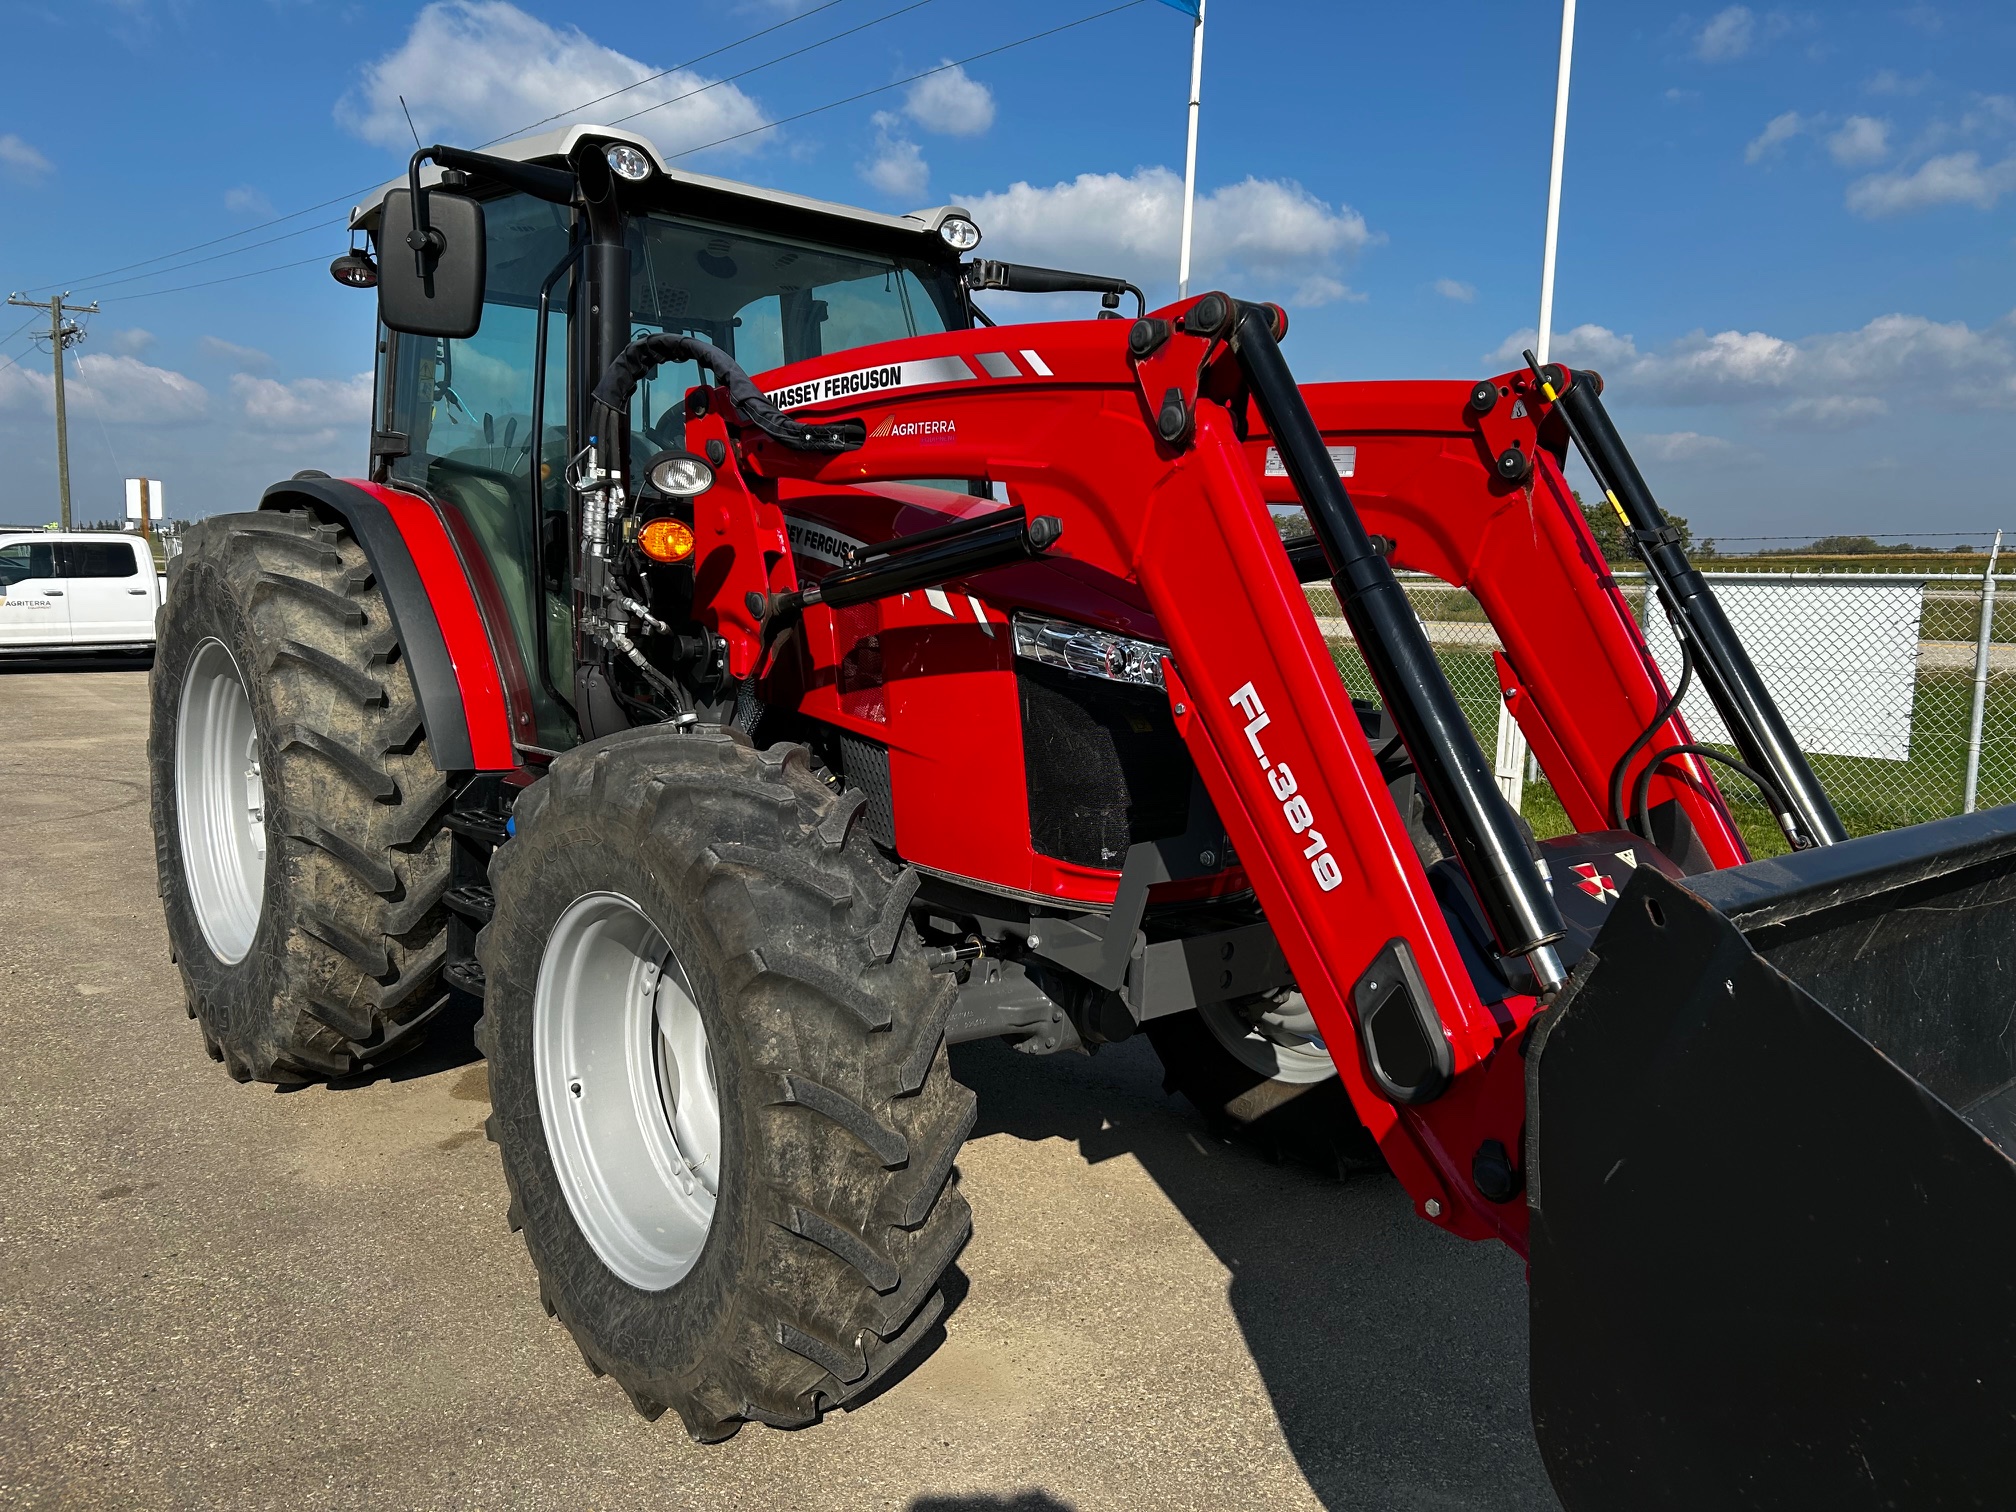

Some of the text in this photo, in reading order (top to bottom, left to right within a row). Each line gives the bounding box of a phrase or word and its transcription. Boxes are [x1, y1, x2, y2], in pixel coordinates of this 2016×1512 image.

[767, 365, 902, 409] MASSEY FERGUSON
[891, 420, 956, 436] AGRITERRA
[1229, 681, 1343, 892] FL.3819
